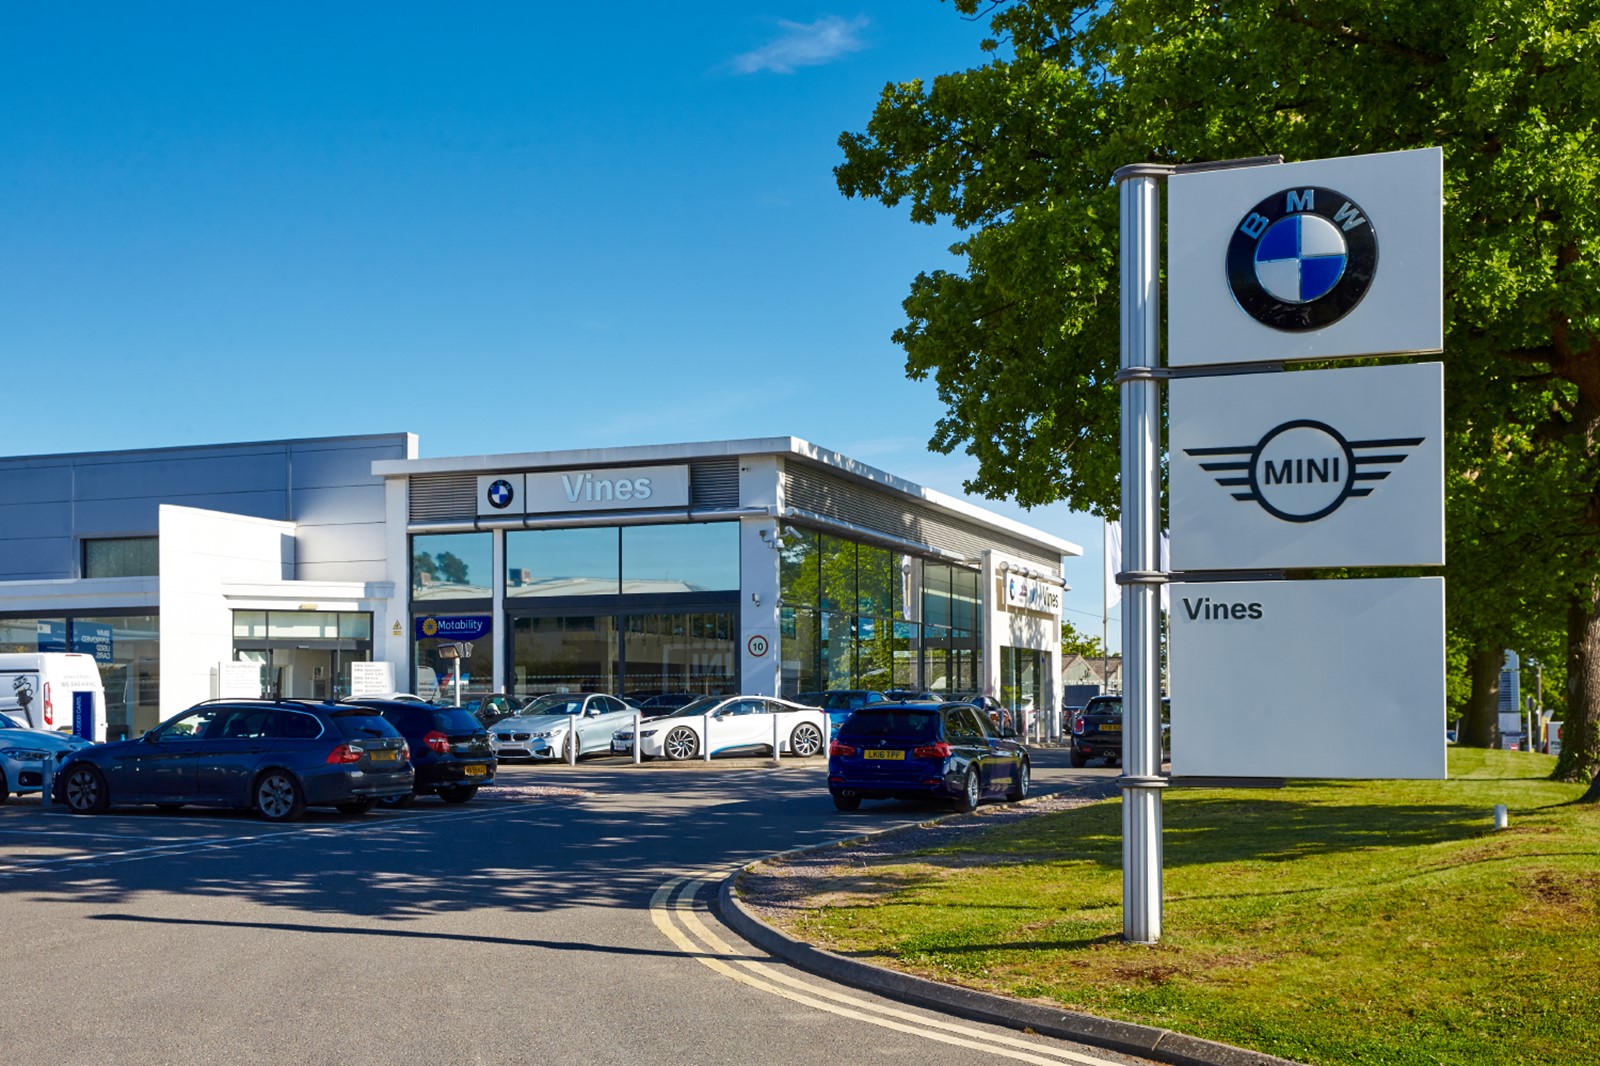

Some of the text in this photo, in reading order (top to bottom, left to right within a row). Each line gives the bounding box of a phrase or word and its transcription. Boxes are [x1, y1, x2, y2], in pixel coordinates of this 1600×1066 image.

[1239, 189, 1367, 240] BMW
[1264, 456, 1340, 485] MINI
[561, 473, 652, 502] Vines
[1042, 586, 1059, 608] Vines
[1182, 597, 1263, 621] Vines
[438, 619, 483, 632] Motability
[753, 642, 764, 651] 10
